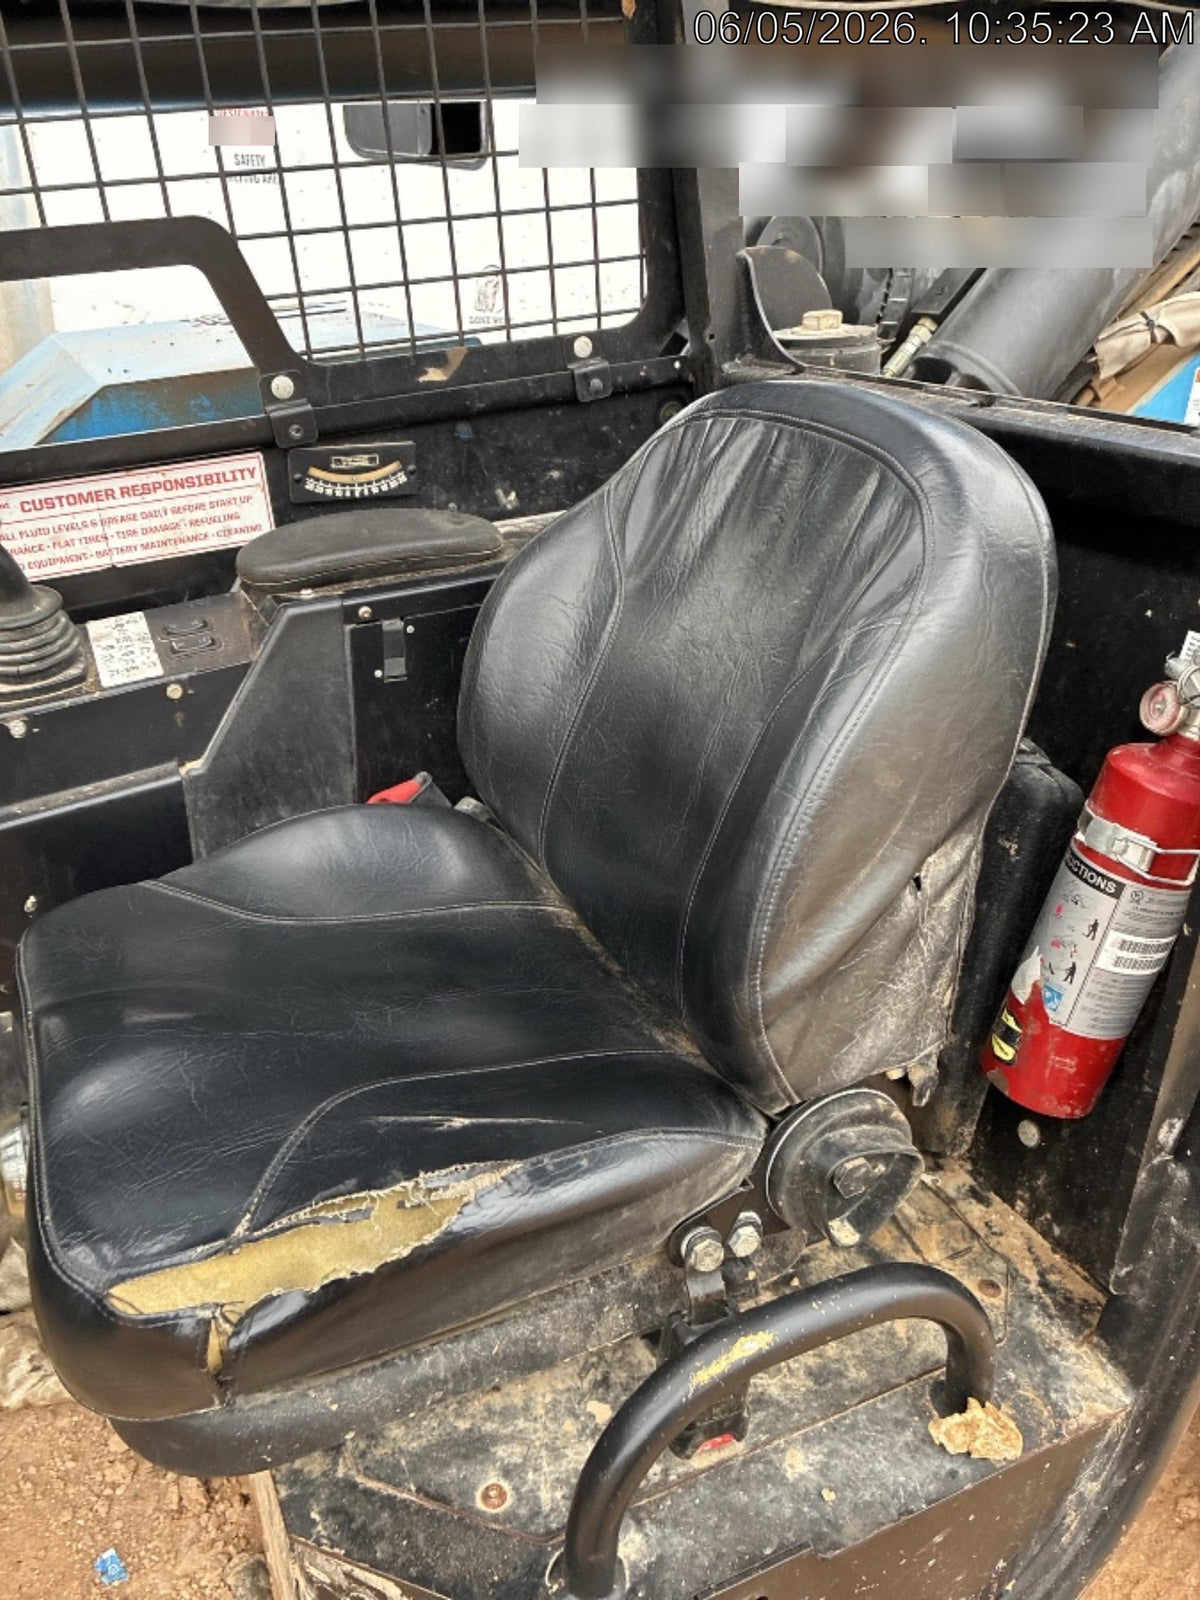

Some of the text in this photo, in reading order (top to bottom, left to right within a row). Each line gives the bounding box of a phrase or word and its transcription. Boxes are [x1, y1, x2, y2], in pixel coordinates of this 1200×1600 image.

[234, 153, 265, 167] SAFETY
[20, 467, 256, 513] CUSTOMER RESPONSIBILITY
[19, 526, 50, 539] FLUID
[53, 520, 88, 534] LEVELS
[140, 505, 168, 520] DAILY
[170, 502, 207, 515] BEFORE
[209, 497, 237, 509] START
[239, 495, 253, 504] UP
[52, 539, 75, 550] FLAT
[80, 533, 109, 545] TIRES
[116, 529, 139, 540] TIRE
[141, 522, 180, 536] DAMAGE
[189, 512, 240, 527] REFUELING
[27, 552, 88, 570] EQUIPMENT
[95, 543, 138, 559] BATTERY
[141, 532, 209, 550] MAINTENANCE
